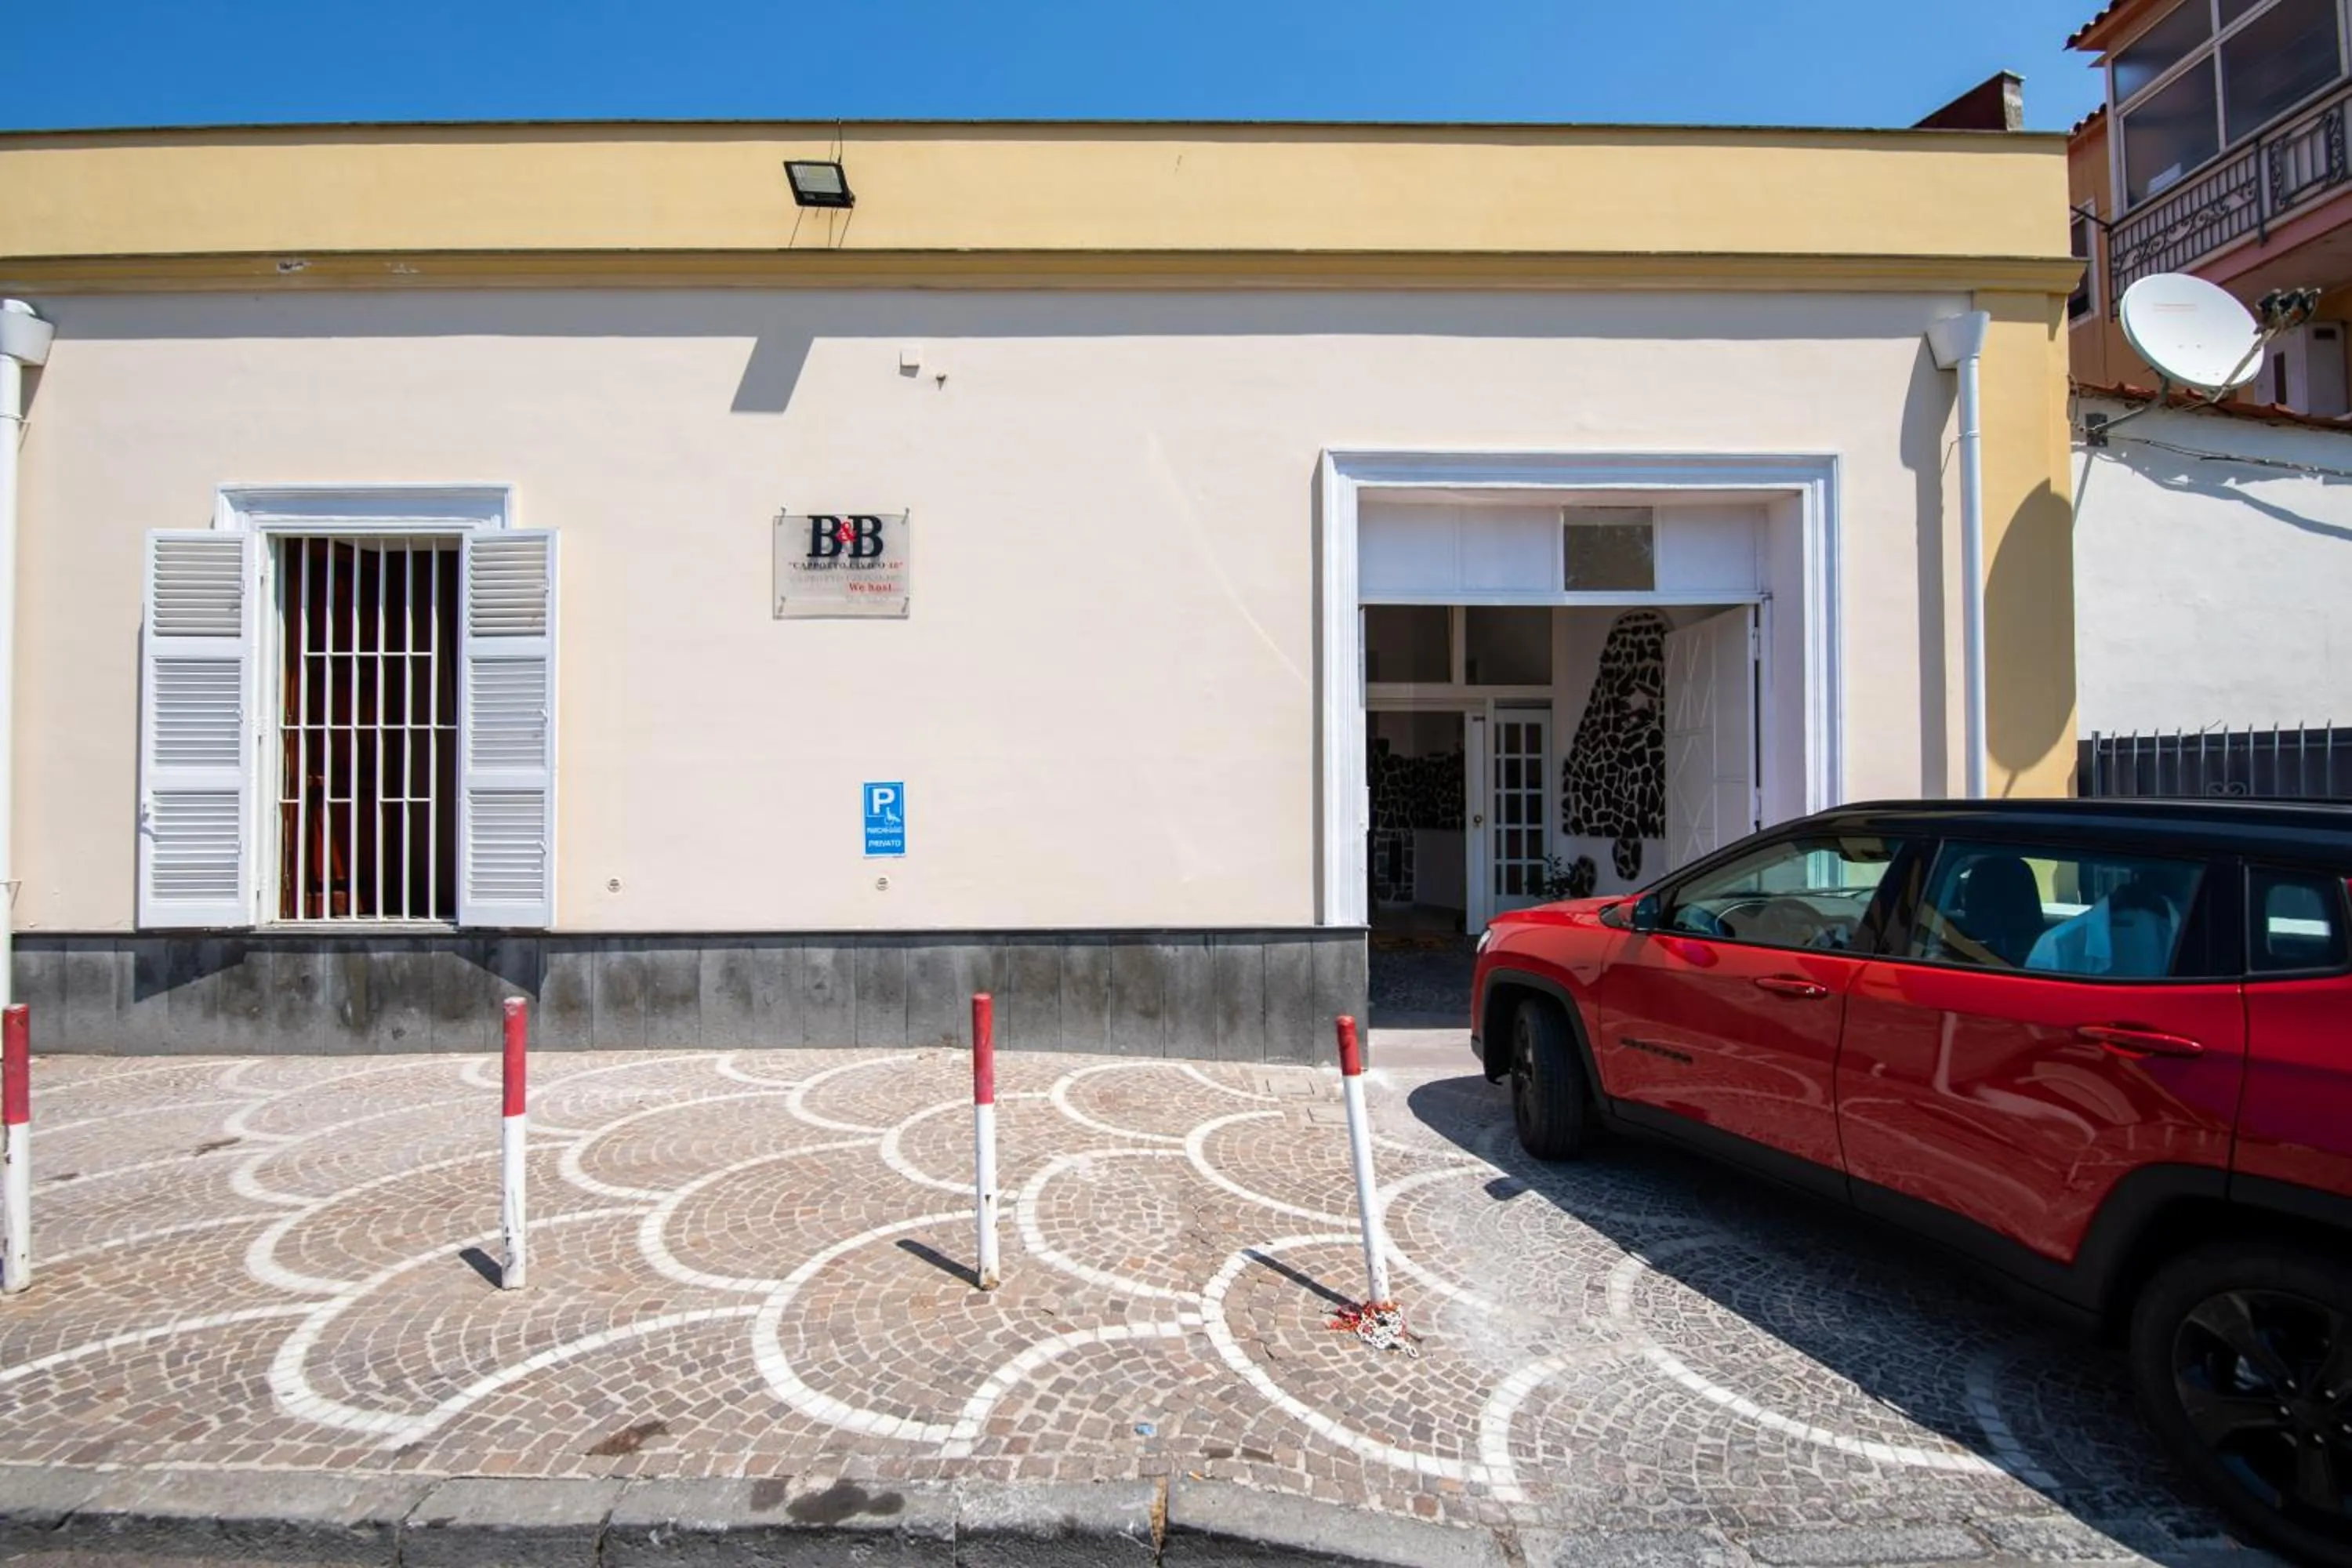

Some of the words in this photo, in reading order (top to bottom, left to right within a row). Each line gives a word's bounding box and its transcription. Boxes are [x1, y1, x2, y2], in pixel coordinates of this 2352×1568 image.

[807, 515, 883, 557] B&B
[849, 583, 866, 592] We
[873, 788, 895, 814] P
